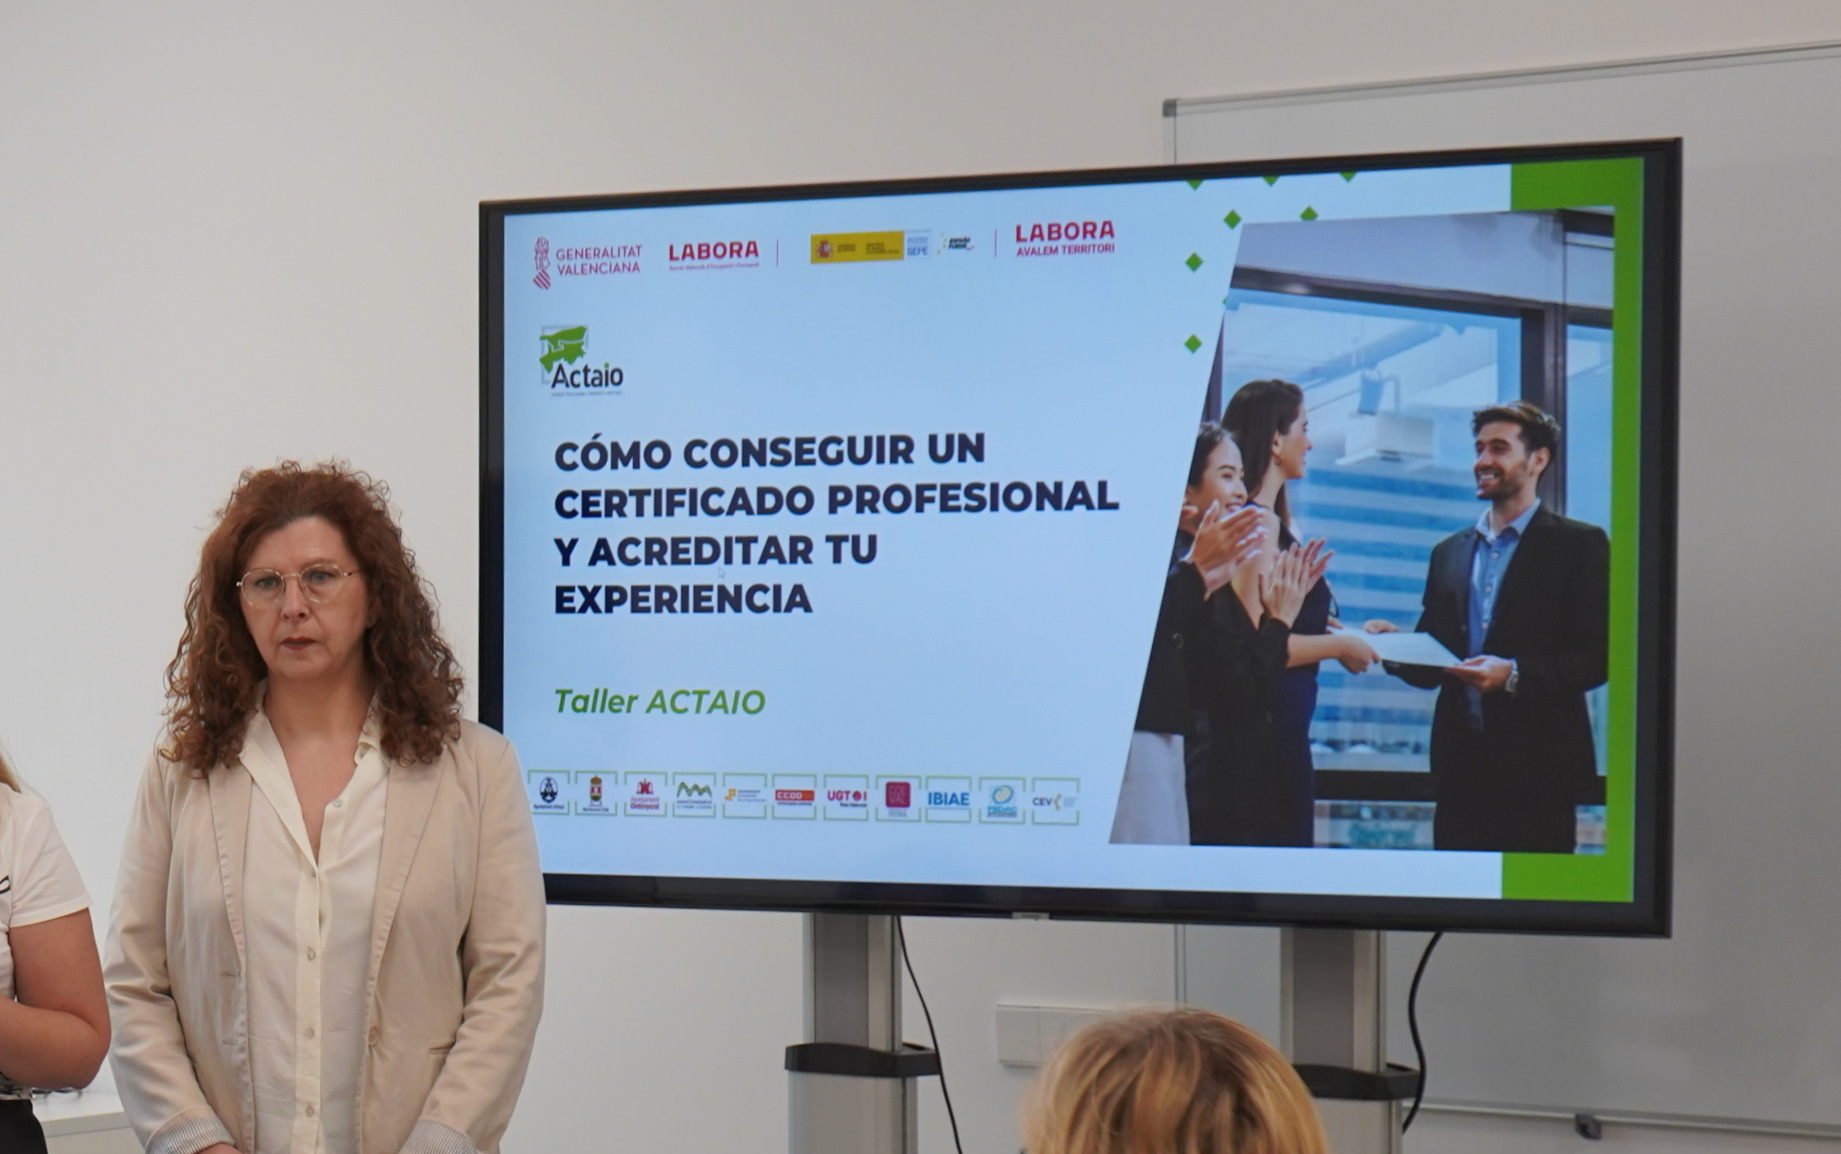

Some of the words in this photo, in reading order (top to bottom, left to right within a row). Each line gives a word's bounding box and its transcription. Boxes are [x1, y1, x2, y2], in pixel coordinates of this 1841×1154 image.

[1016, 221, 1114, 243] LABORA
[556, 245, 642, 261] GENERALITAT
[669, 241, 759, 261] LABORA
[1017, 246, 1058, 256] AVALEM
[1062, 244, 1114, 254] TERRITORI
[557, 262, 640, 275] VALENCIANA
[551, 362, 623, 389] Actaio
[555, 433, 671, 471] CÓMO
[684, 435, 914, 469] CONSEGUIR
[928, 433, 984, 464] UN
[555, 486, 814, 519] CERTIFICADO
[828, 480, 1119, 514] PROFESIONAL
[554, 538, 578, 566] Y
[588, 536, 813, 566] ACREDITAR
[825, 534, 877, 564] TU
[555, 584, 812, 614] EXPERIENCIA
[555, 688, 638, 713] Taller
[645, 690, 765, 715] ACTAIO
[776, 791, 802, 799] CCOO
[828, 790, 850, 801] UGT
[928, 792, 969, 806] IBIAE
[1032, 797, 1052, 806] CEV
